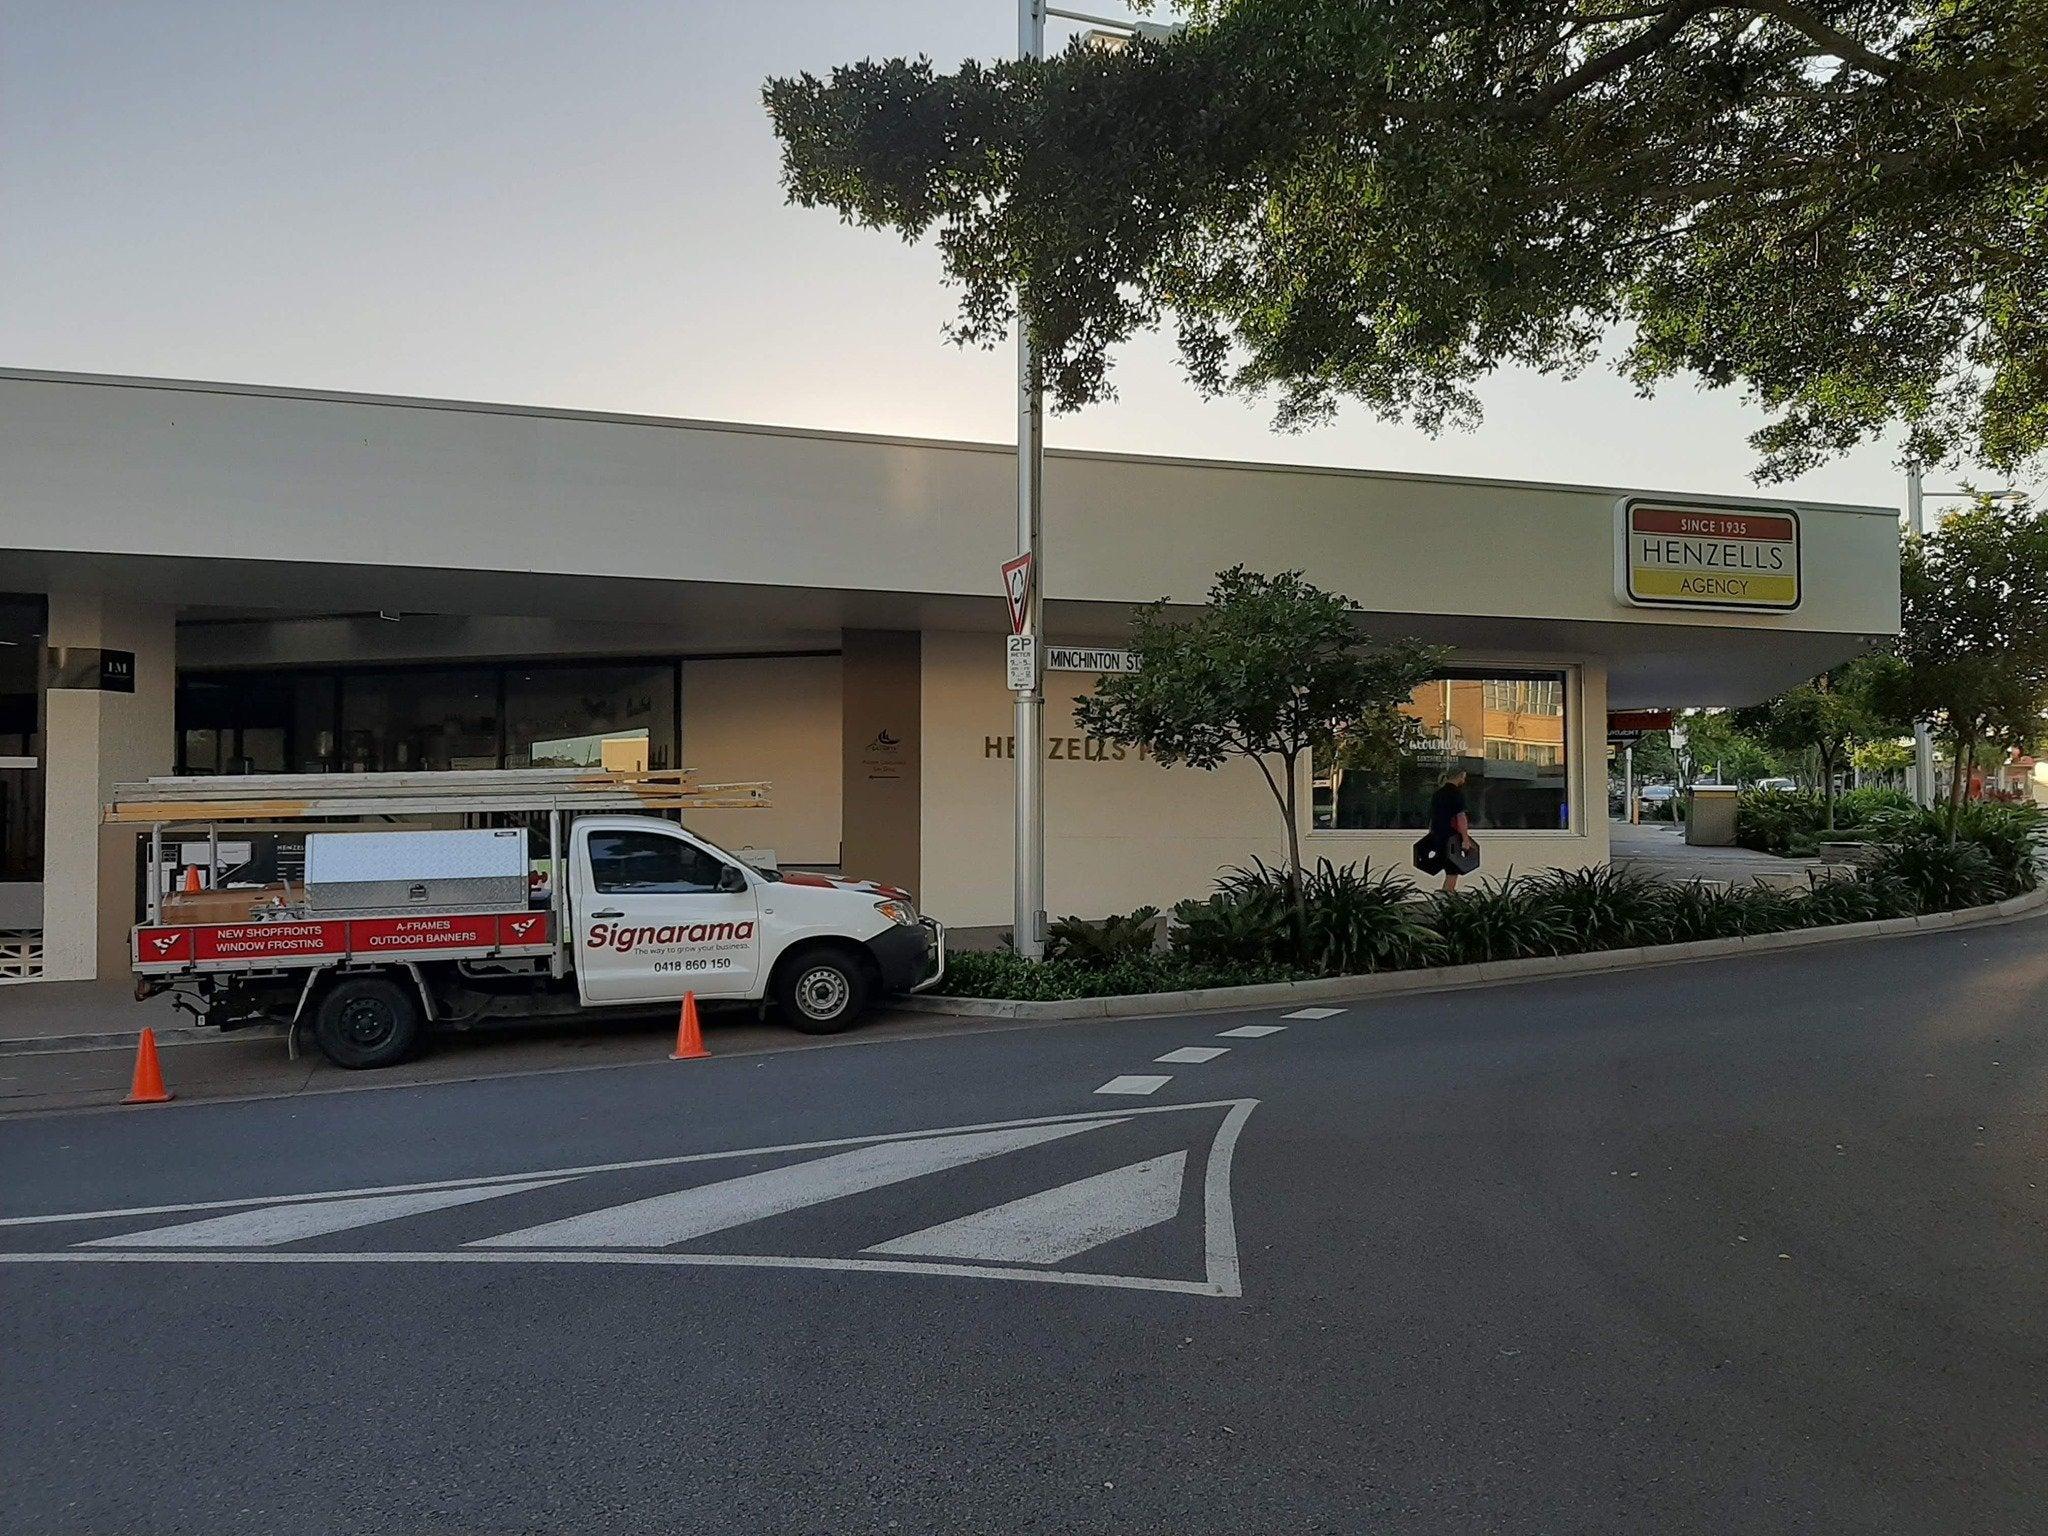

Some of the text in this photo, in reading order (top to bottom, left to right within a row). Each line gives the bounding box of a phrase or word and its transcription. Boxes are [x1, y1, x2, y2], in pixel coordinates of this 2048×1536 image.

[1681, 519, 1747, 534] SINCE 1935
[1643, 539, 1783, 570] HENZELLS
[1680, 577, 1749, 595] AGENCY
[1010, 637, 1031, 651] 2P
[1050, 650, 1140, 670] MINCHINTON ST
[985, 736, 1126, 761] HEZELLS
[218, 926, 322, 939] NEW SHOPFRONTS
[396, 921, 451, 931] A-FRAMES
[369, 932, 477, 946] OUTDOOR BANNERS
[587, 921, 754, 953] Signarama
[216, 939, 324, 952] WINDOW FROSTING
[634, 947, 648, 955] The
[650, 947, 665, 955] way
[677, 946, 696, 955] grow
[698, 944, 714, 953] your
[716, 942, 751, 951] business.
[654, 958, 731, 972] 0418 860 150
